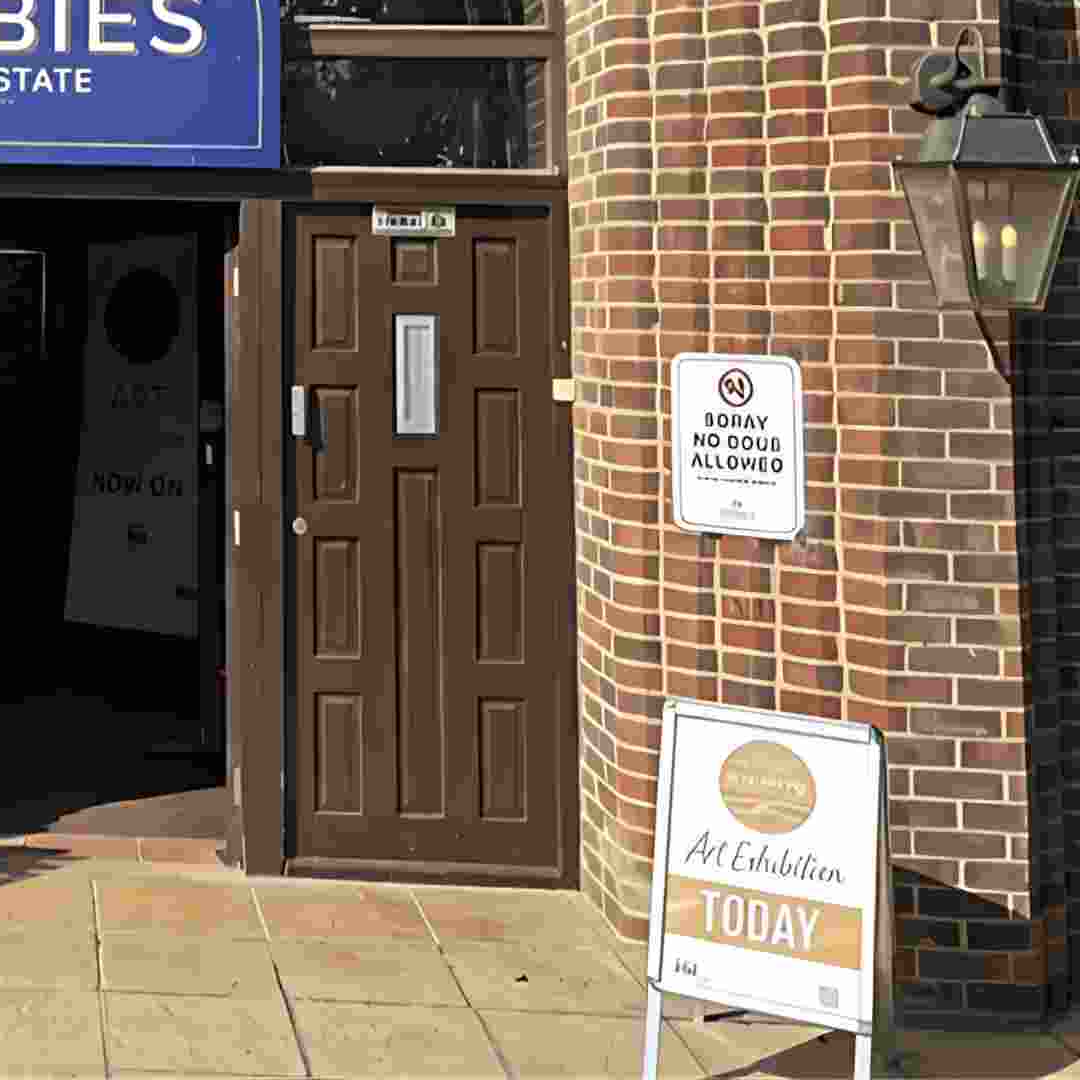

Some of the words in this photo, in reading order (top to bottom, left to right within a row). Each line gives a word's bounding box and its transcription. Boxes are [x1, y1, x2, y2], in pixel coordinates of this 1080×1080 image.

[693, 432, 721, 449] NO
[684, 828, 727, 864] Art
[699, 888, 821, 952] TODAY
